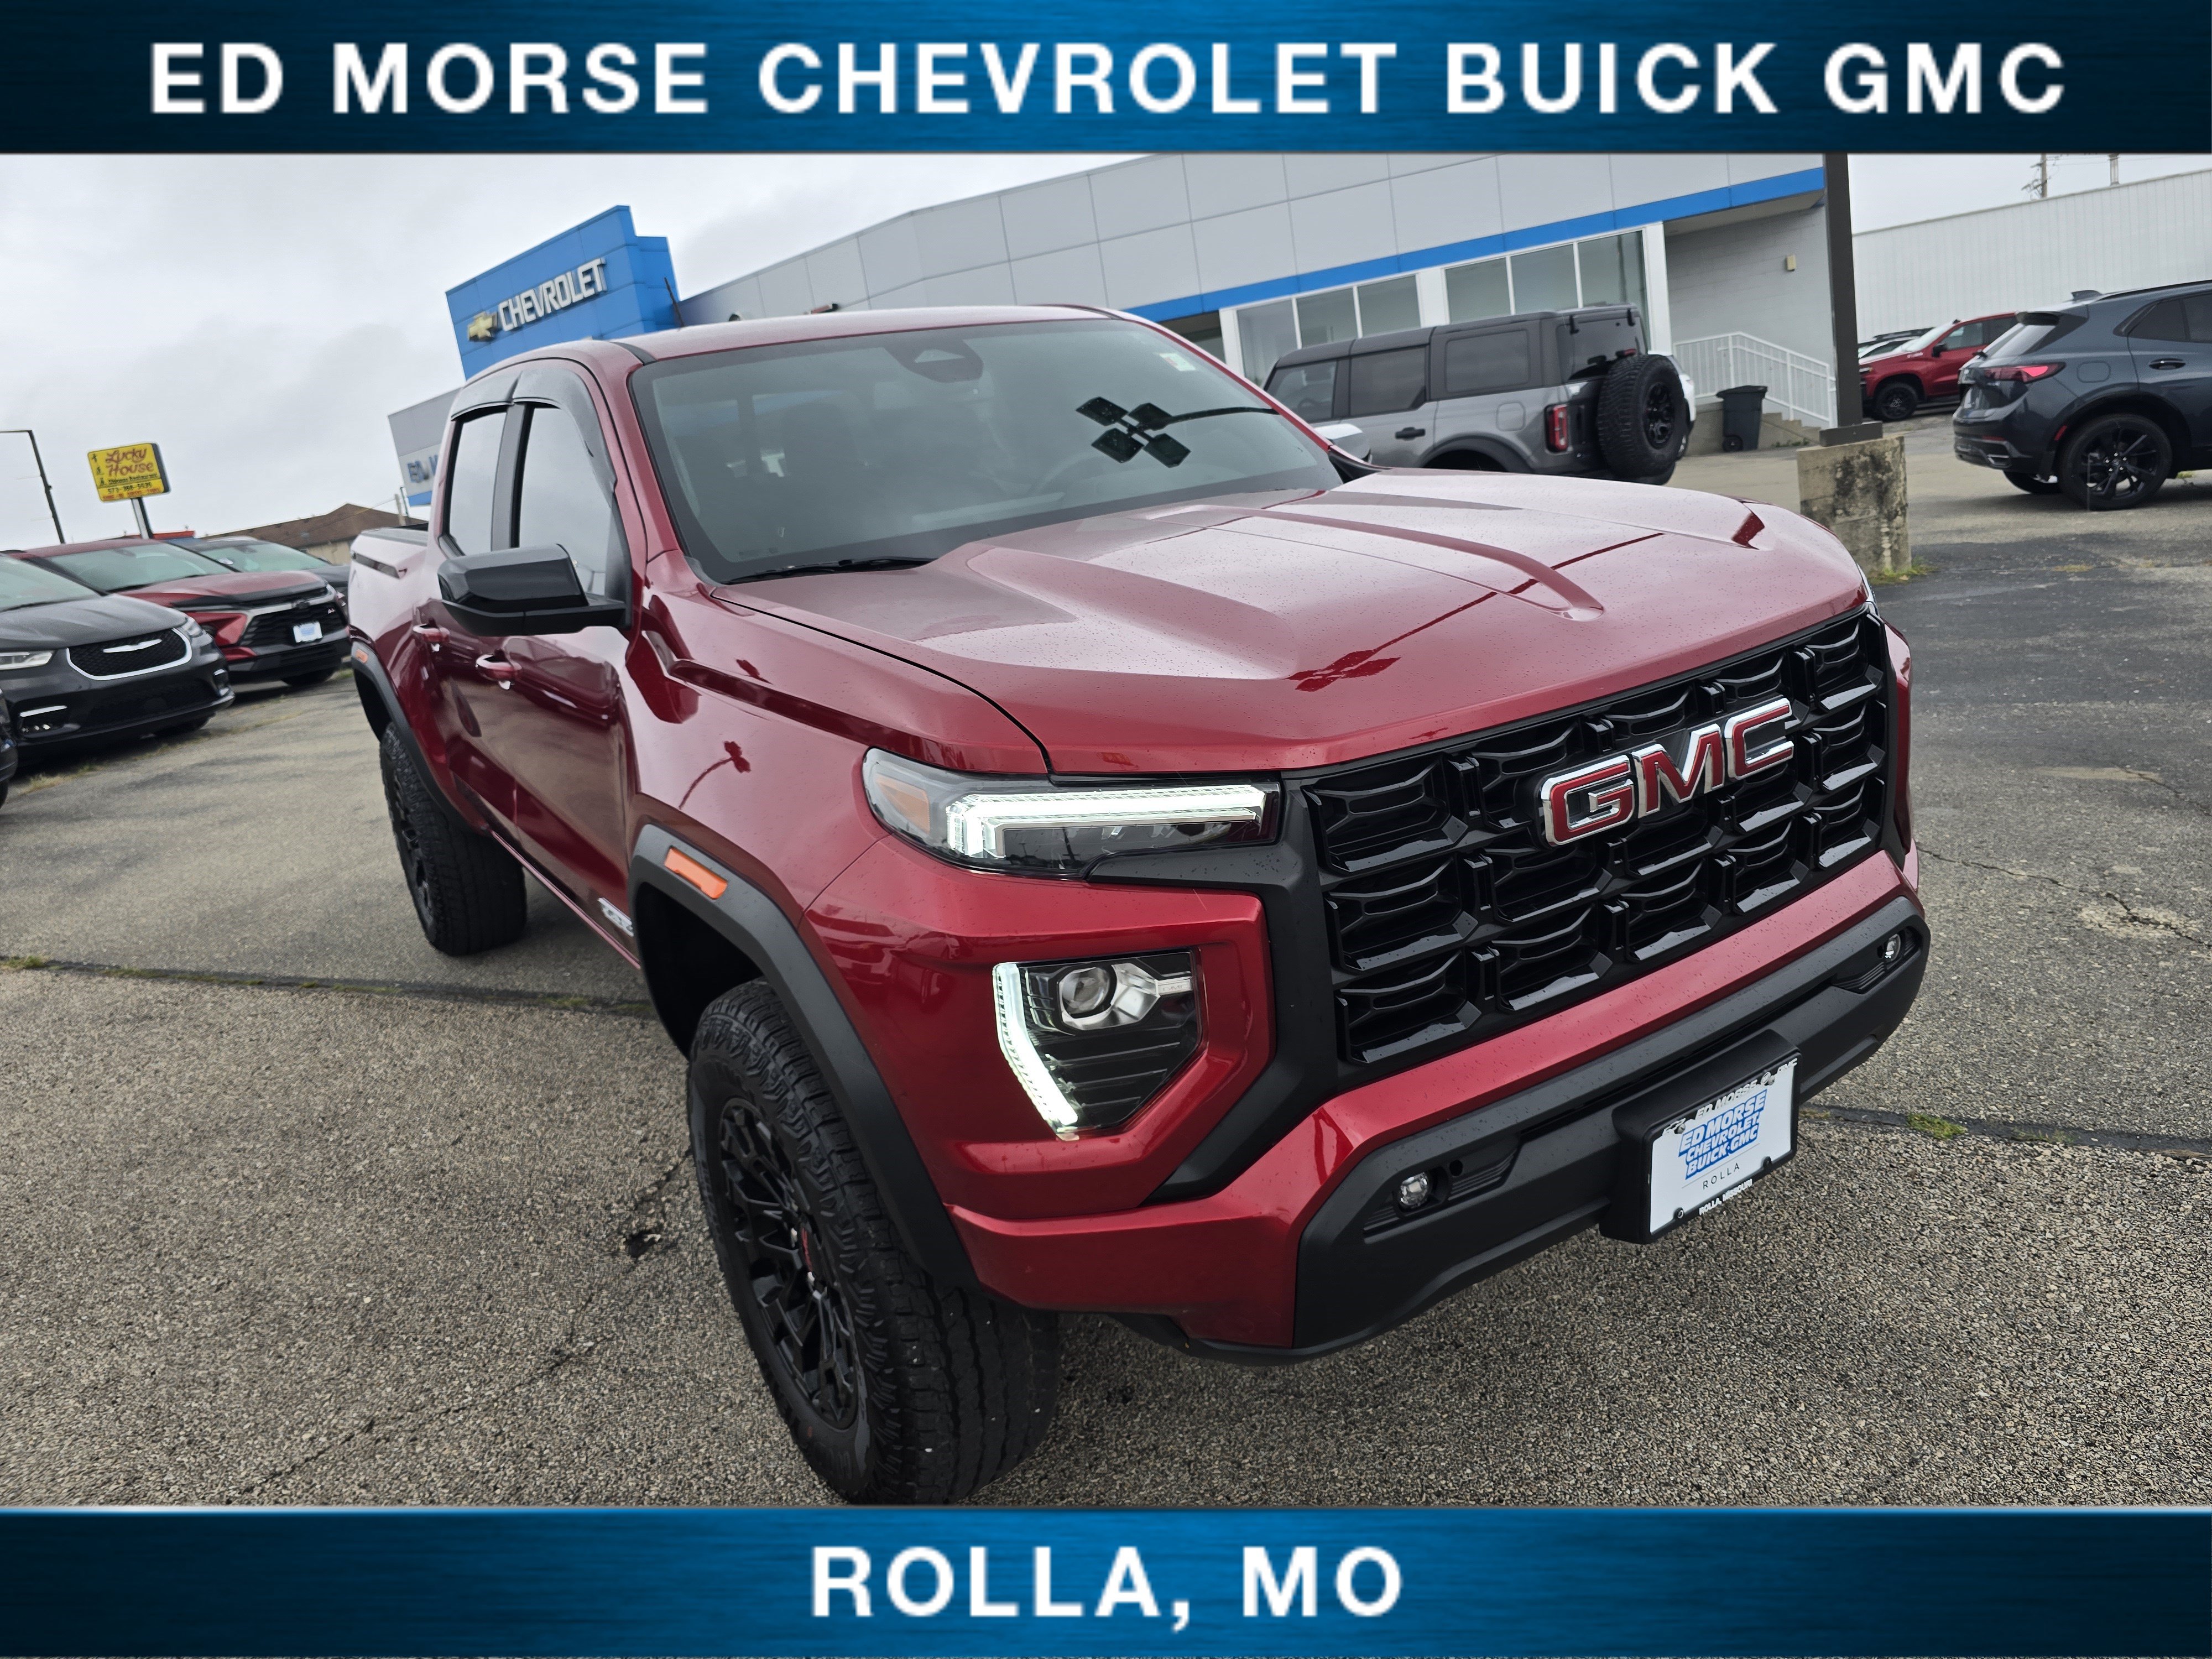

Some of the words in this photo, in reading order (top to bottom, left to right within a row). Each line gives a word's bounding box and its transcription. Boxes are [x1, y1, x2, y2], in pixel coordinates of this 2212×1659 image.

[498, 258, 607, 332] CHEVROLET
[1541, 697, 1794, 846] GMC
[1678, 1124, 1707, 1157] ED
[1705, 1089, 1767, 1139] MORSE
[1703, 1162, 1740, 1190] ROLLA
